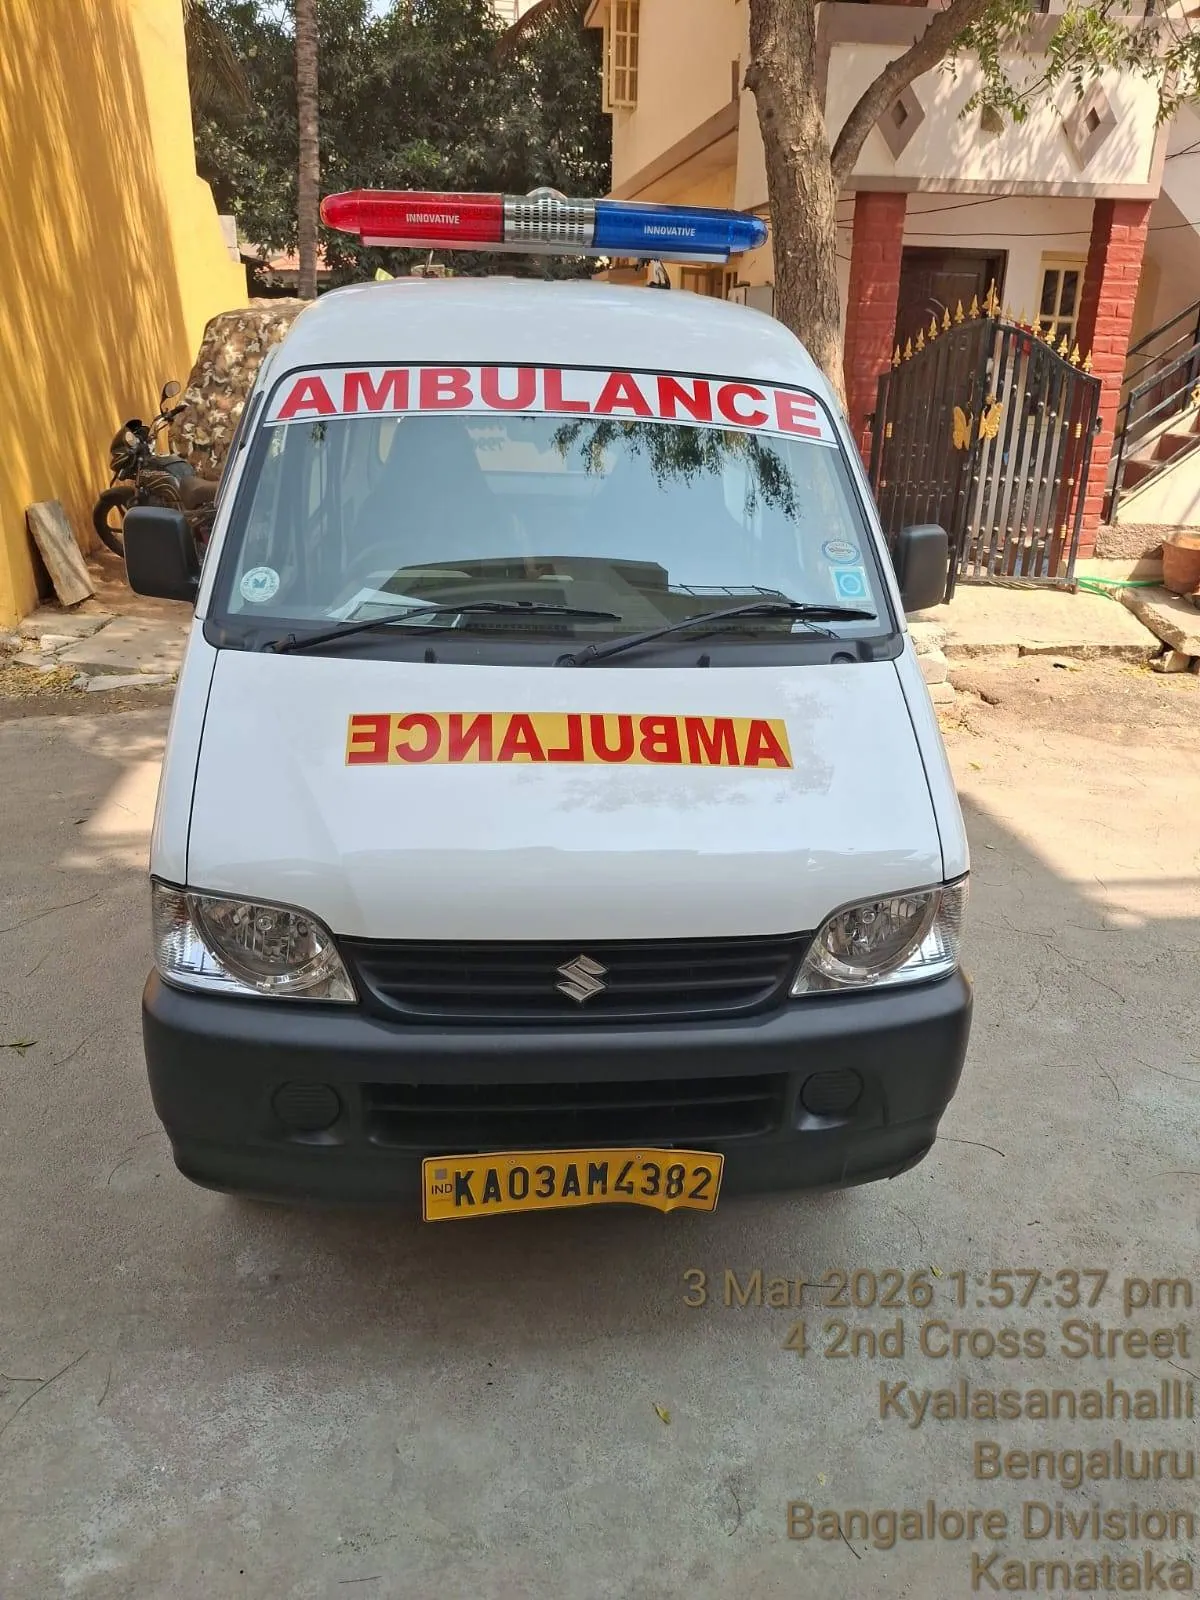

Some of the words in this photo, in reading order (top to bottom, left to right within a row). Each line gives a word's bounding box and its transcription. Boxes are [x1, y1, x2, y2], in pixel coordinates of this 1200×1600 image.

[406, 213, 460, 225] INNOVATIVE
[643, 225, 697, 238] INNOVATIVE
[276, 367, 821, 436] AMBULANCE
[431, 1183, 452, 1195] IND
[454, 1160, 712, 1206] KA03AM4382
